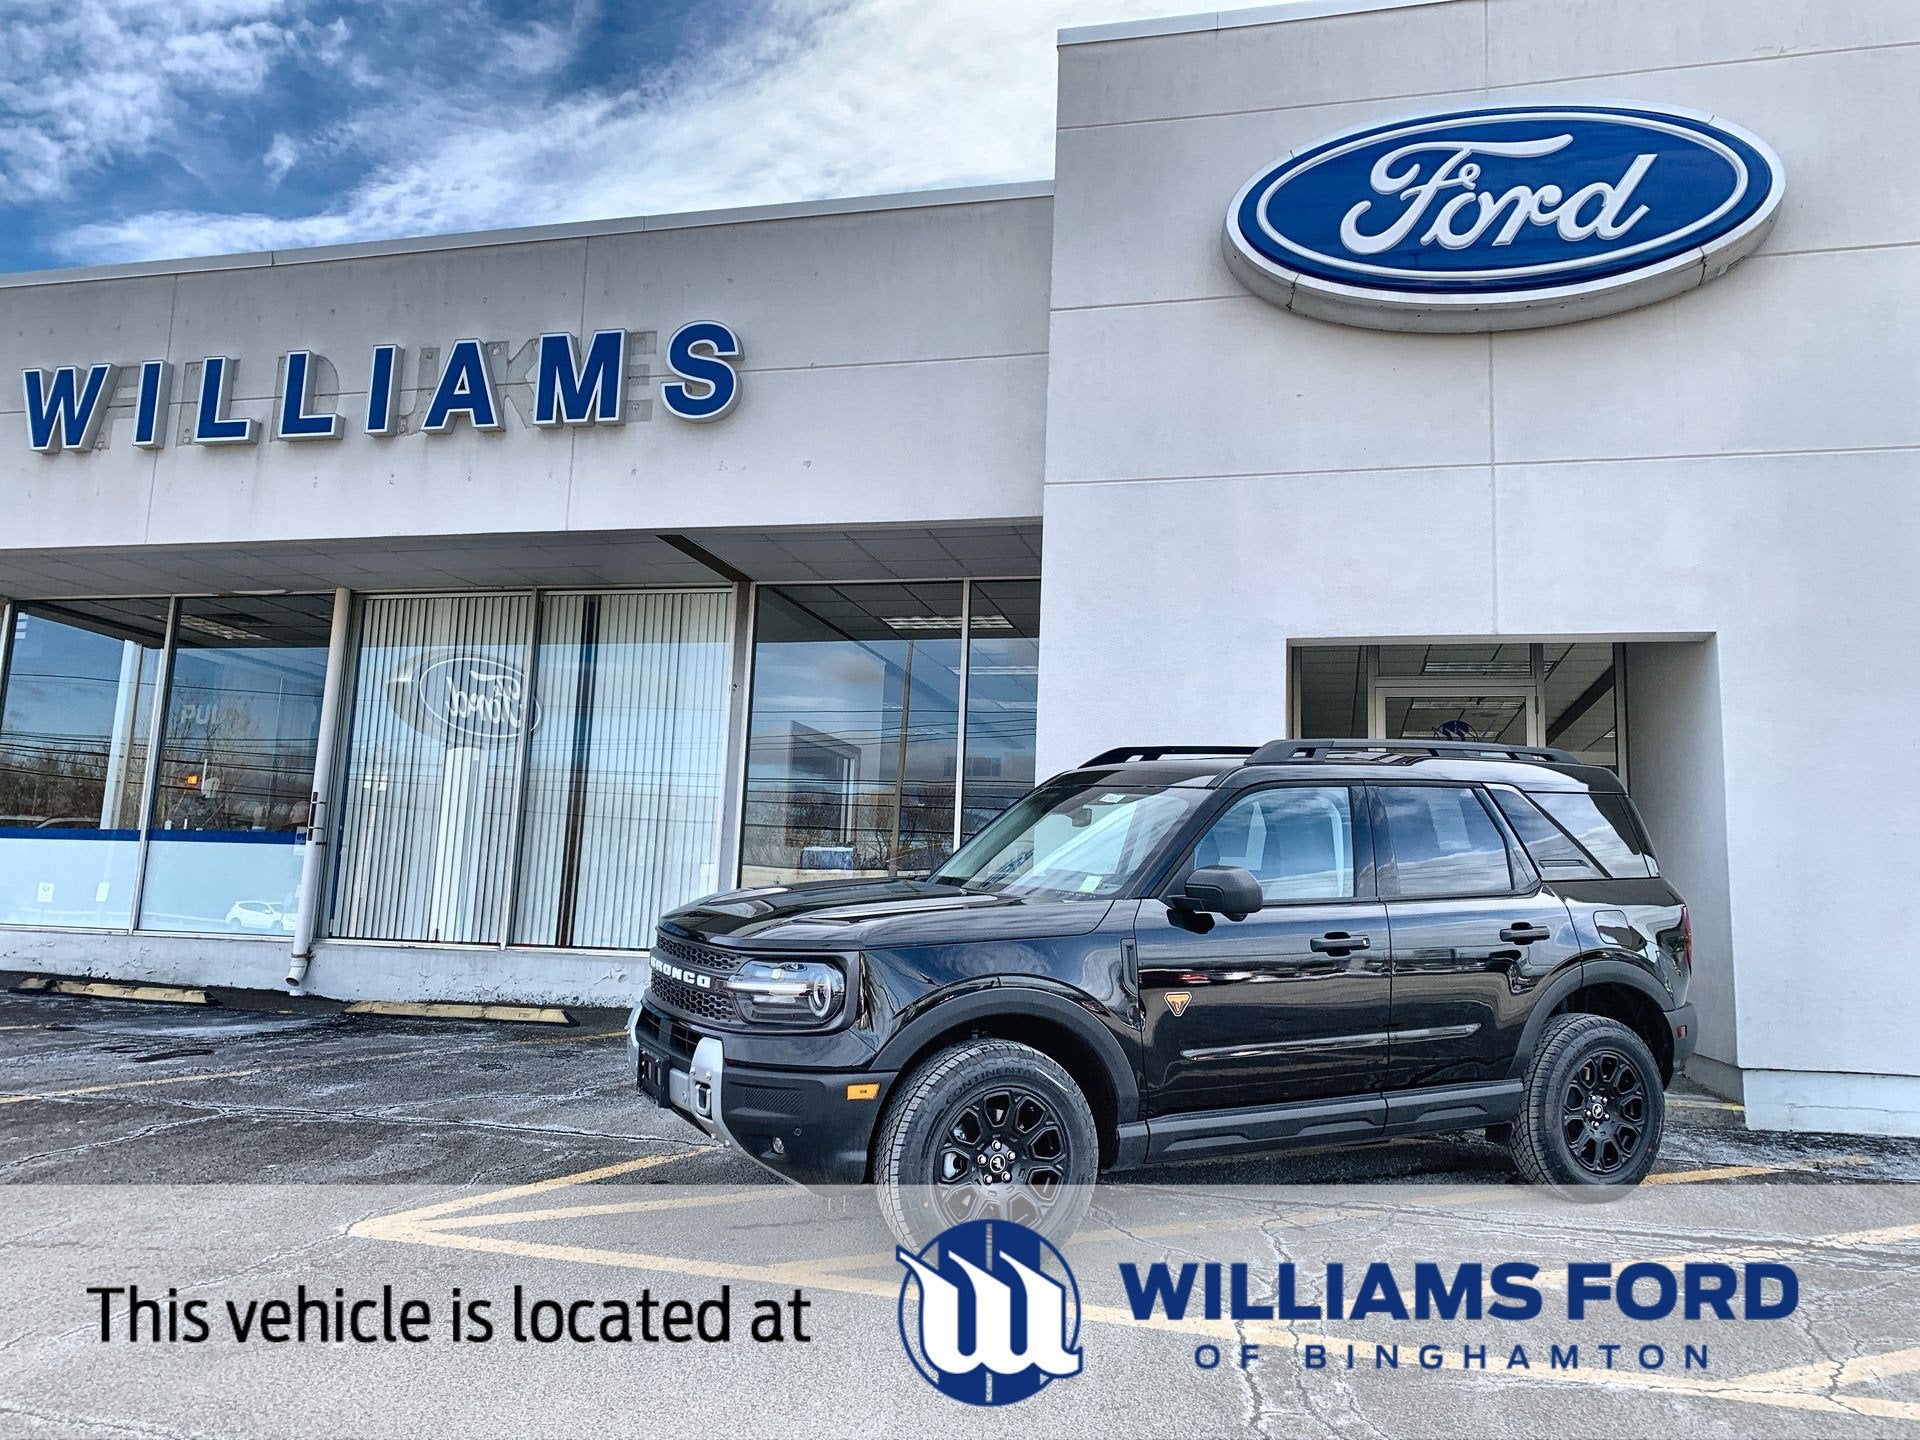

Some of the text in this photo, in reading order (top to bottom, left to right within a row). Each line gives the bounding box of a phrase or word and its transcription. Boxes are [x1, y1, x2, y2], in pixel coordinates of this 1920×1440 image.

[1339, 133, 1658, 255] Ford
[22, 320, 744, 454] WILLIAMS
[649, 955, 712, 990] BRONCO
